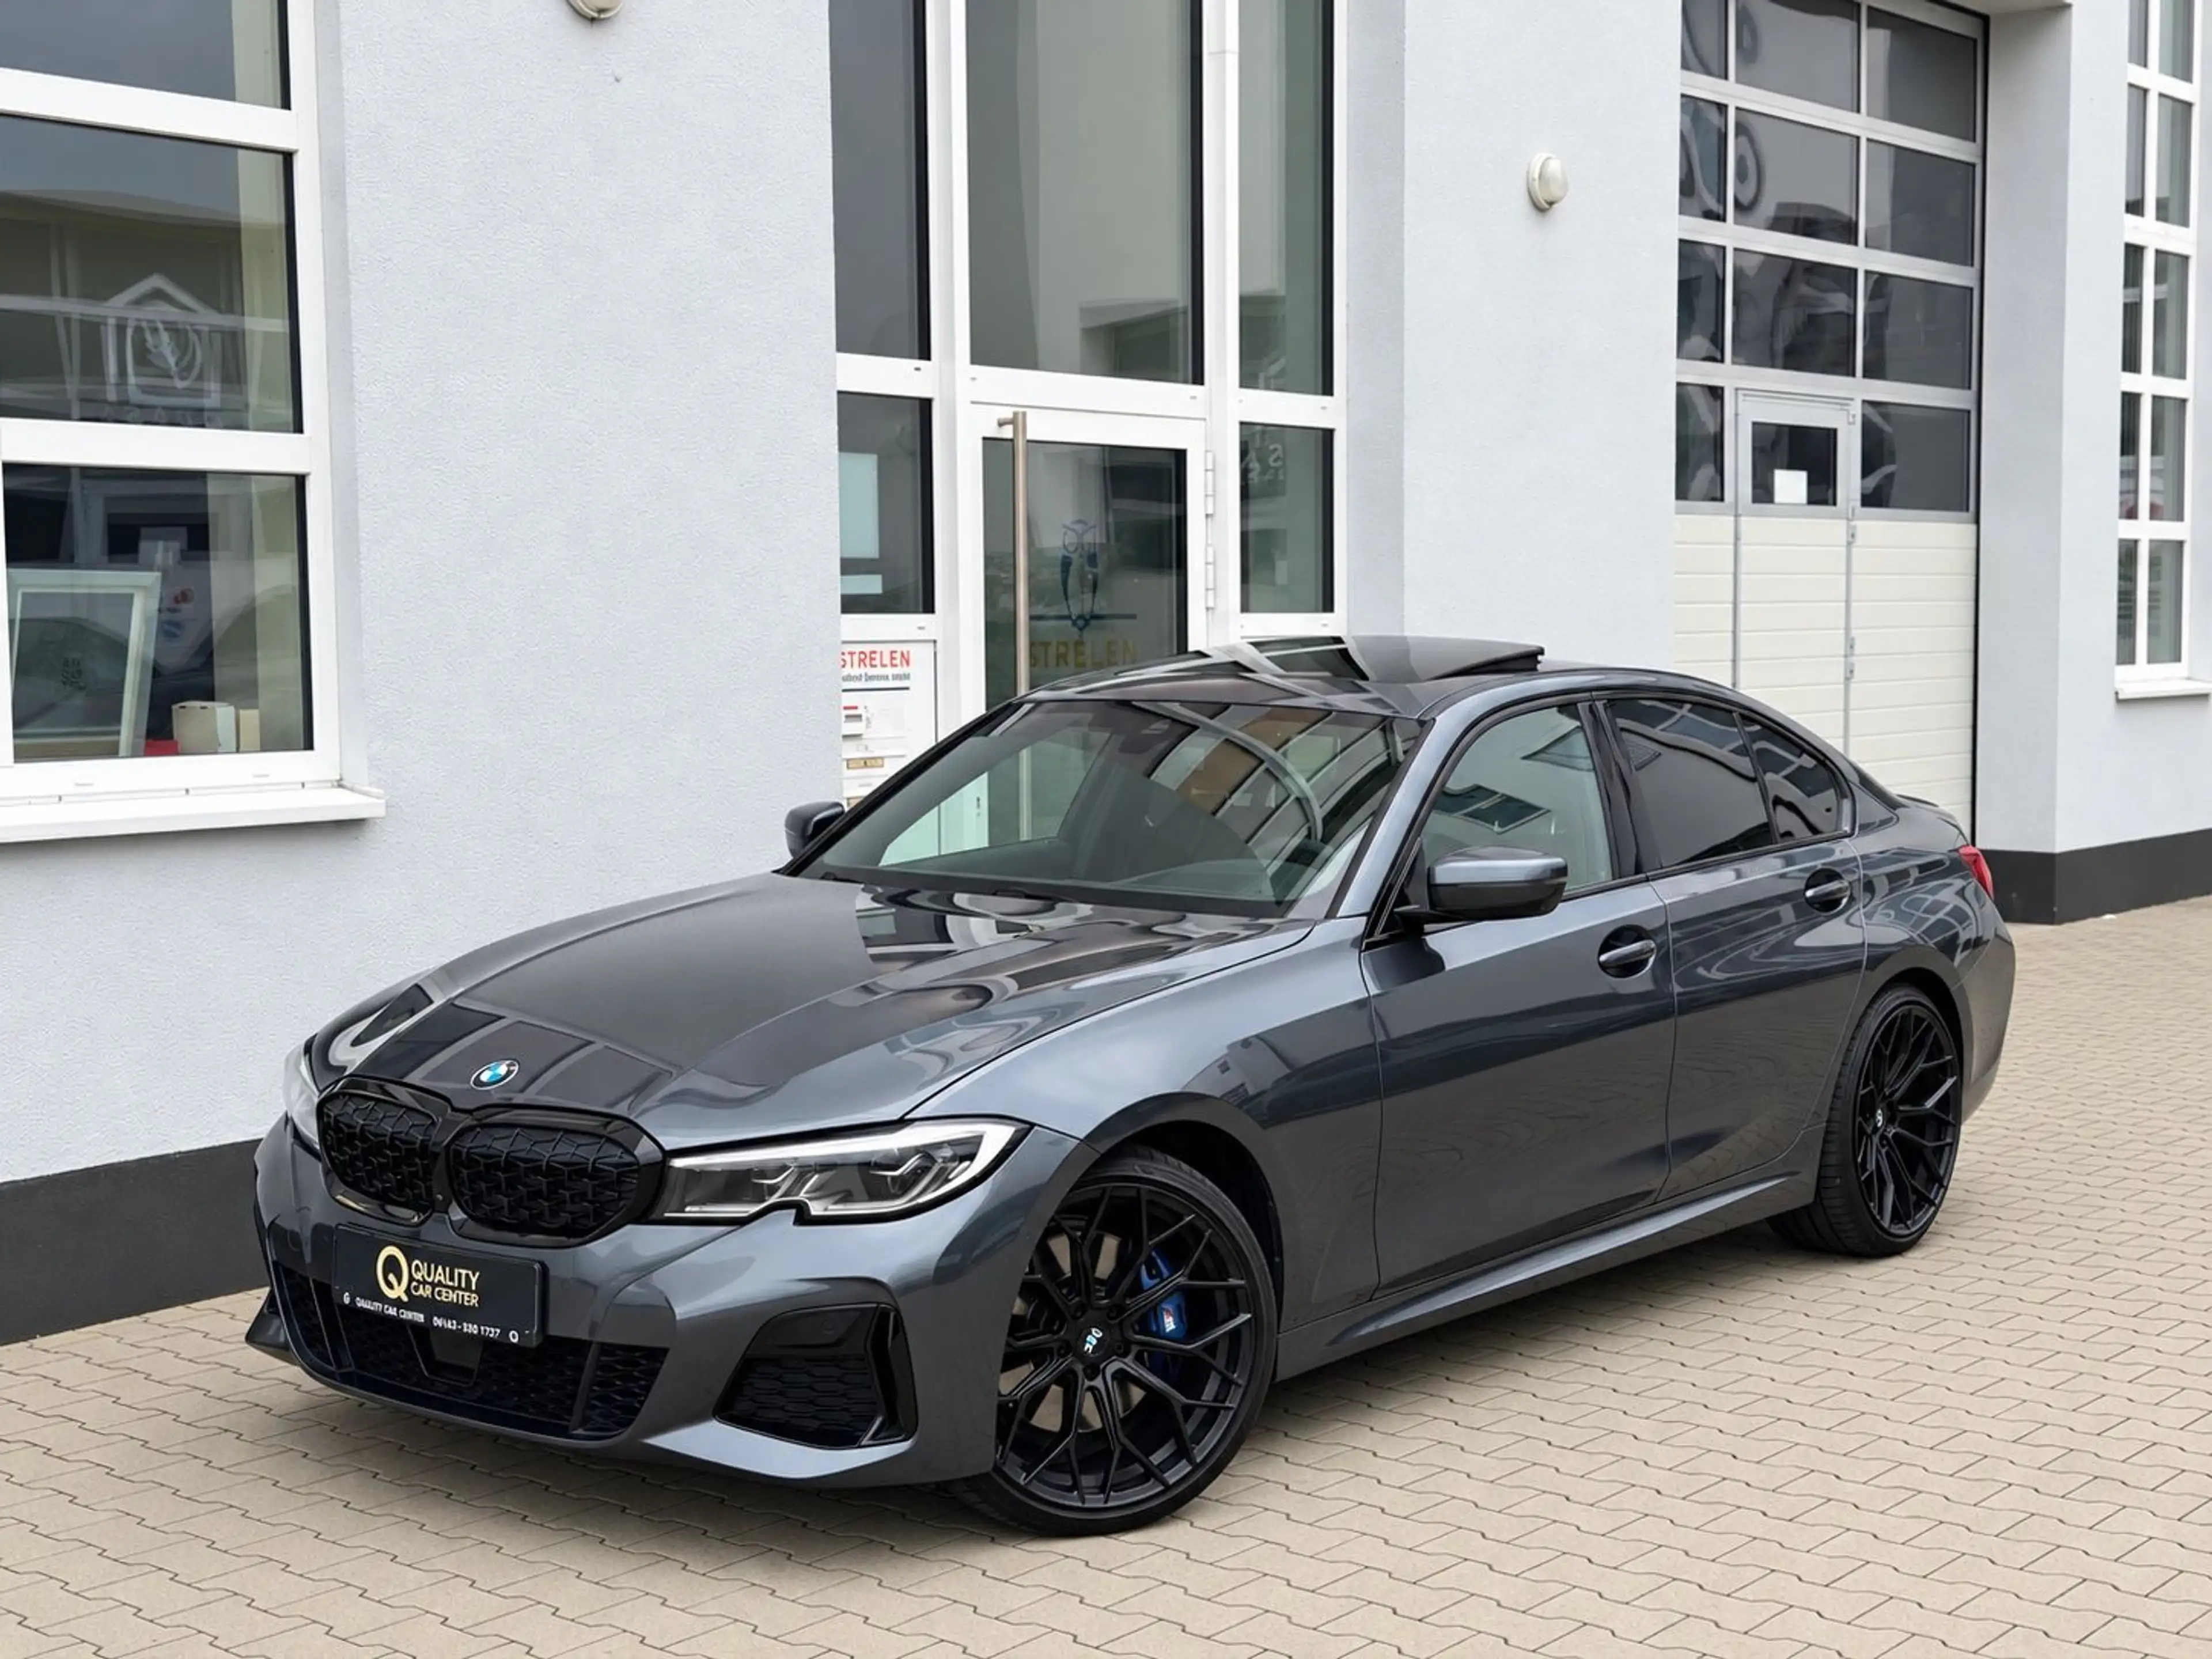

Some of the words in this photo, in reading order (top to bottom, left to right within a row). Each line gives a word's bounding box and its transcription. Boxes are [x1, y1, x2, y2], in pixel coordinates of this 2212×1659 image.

[841, 650, 910, 668] STRELEN
[411, 1259, 480, 1291] QUALITY
[410, 1282, 432, 1299] CAR
[434, 1286, 479, 1308] CENTER
